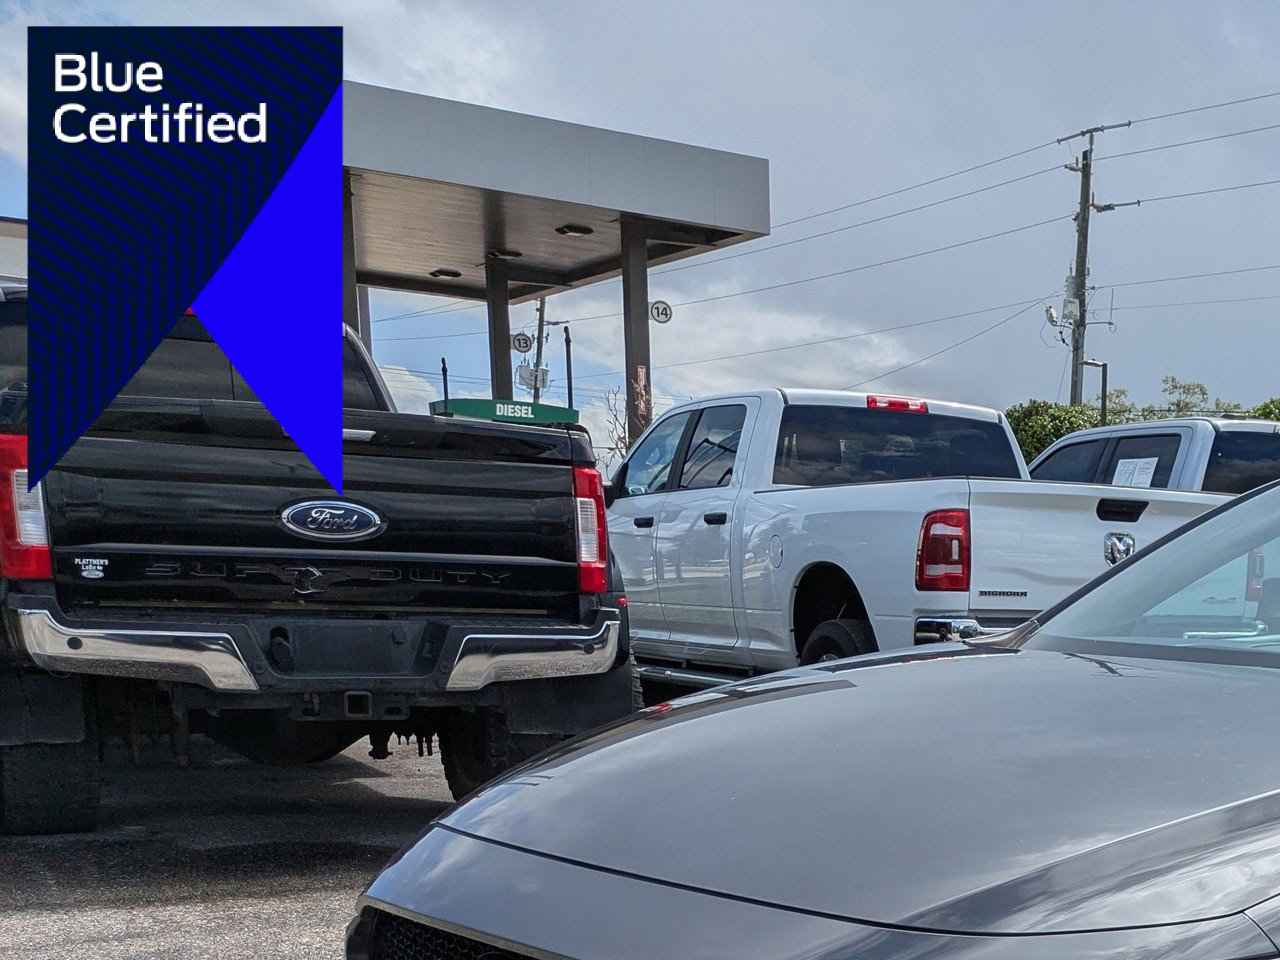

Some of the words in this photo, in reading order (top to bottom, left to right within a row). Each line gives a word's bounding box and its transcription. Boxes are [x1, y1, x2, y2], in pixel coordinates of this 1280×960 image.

[653, 306, 669, 319] 14
[516, 338, 529, 349] 13
[496, 403, 535, 418] DIESEL
[307, 507, 358, 530] Ford
